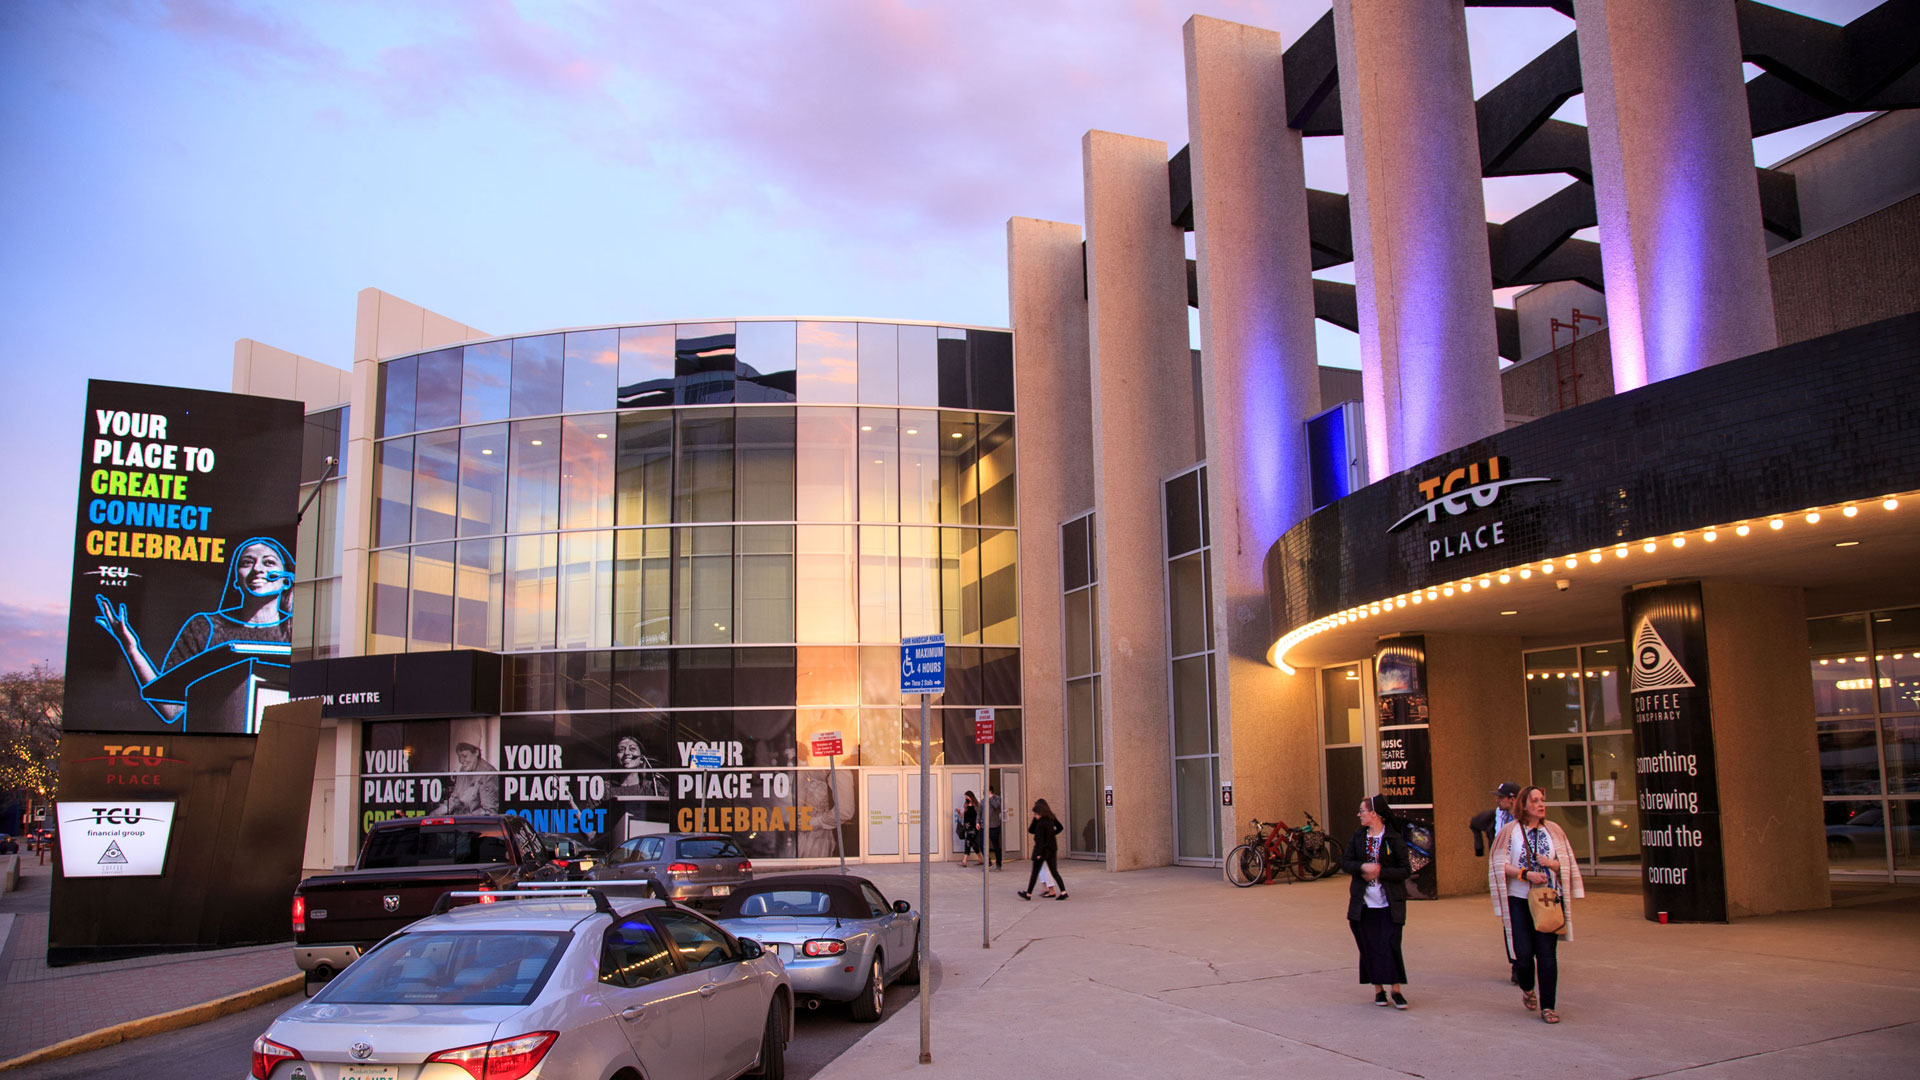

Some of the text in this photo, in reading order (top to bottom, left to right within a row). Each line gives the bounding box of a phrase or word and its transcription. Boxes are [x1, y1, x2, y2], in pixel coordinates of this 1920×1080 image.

[96, 409, 167, 440] YOUR
[93, 439, 215, 473] PLACE TO
[91, 469, 188, 500] CREATE
[1419, 456, 1500, 523] TCU
[88, 499, 212, 531] CONNECT
[86, 530, 226, 563] CELEBRATE
[1429, 521, 1505, 561] PLACE
[98, 566, 129, 579] TCU
[100, 579, 128, 587] PLACE
[915, 647, 943, 659] MAXIMUM
[917, 662, 941, 673] 4 HOURS
[339, 692, 380, 705] CENTRE
[1635, 693, 1680, 712] COFFEE
[1636, 710, 1681, 723] CONSPIRACY
[104, 745, 164, 767] TCU
[365, 749, 409, 773] YOUR
[504, 744, 562, 770] YOUR
[1637, 750, 1698, 776] something
[107, 774, 161, 785] PLACE
[364, 778, 442, 804] PLACE TO
[504, 775, 604, 801] PLACE TO
[760, 772, 790, 798] TO
[1398, 776, 1416, 785] THE
[1640, 790, 1645, 810] is
[1646, 788, 1699, 814] brewing
[92, 808, 141, 825] TCU
[505, 808, 607, 834] ONNECT
[677, 806, 813, 832] CELEBRATE
[87, 829, 145, 839] financial group
[1642, 824, 1703, 847] around the
[1649, 866, 1688, 885] corner
